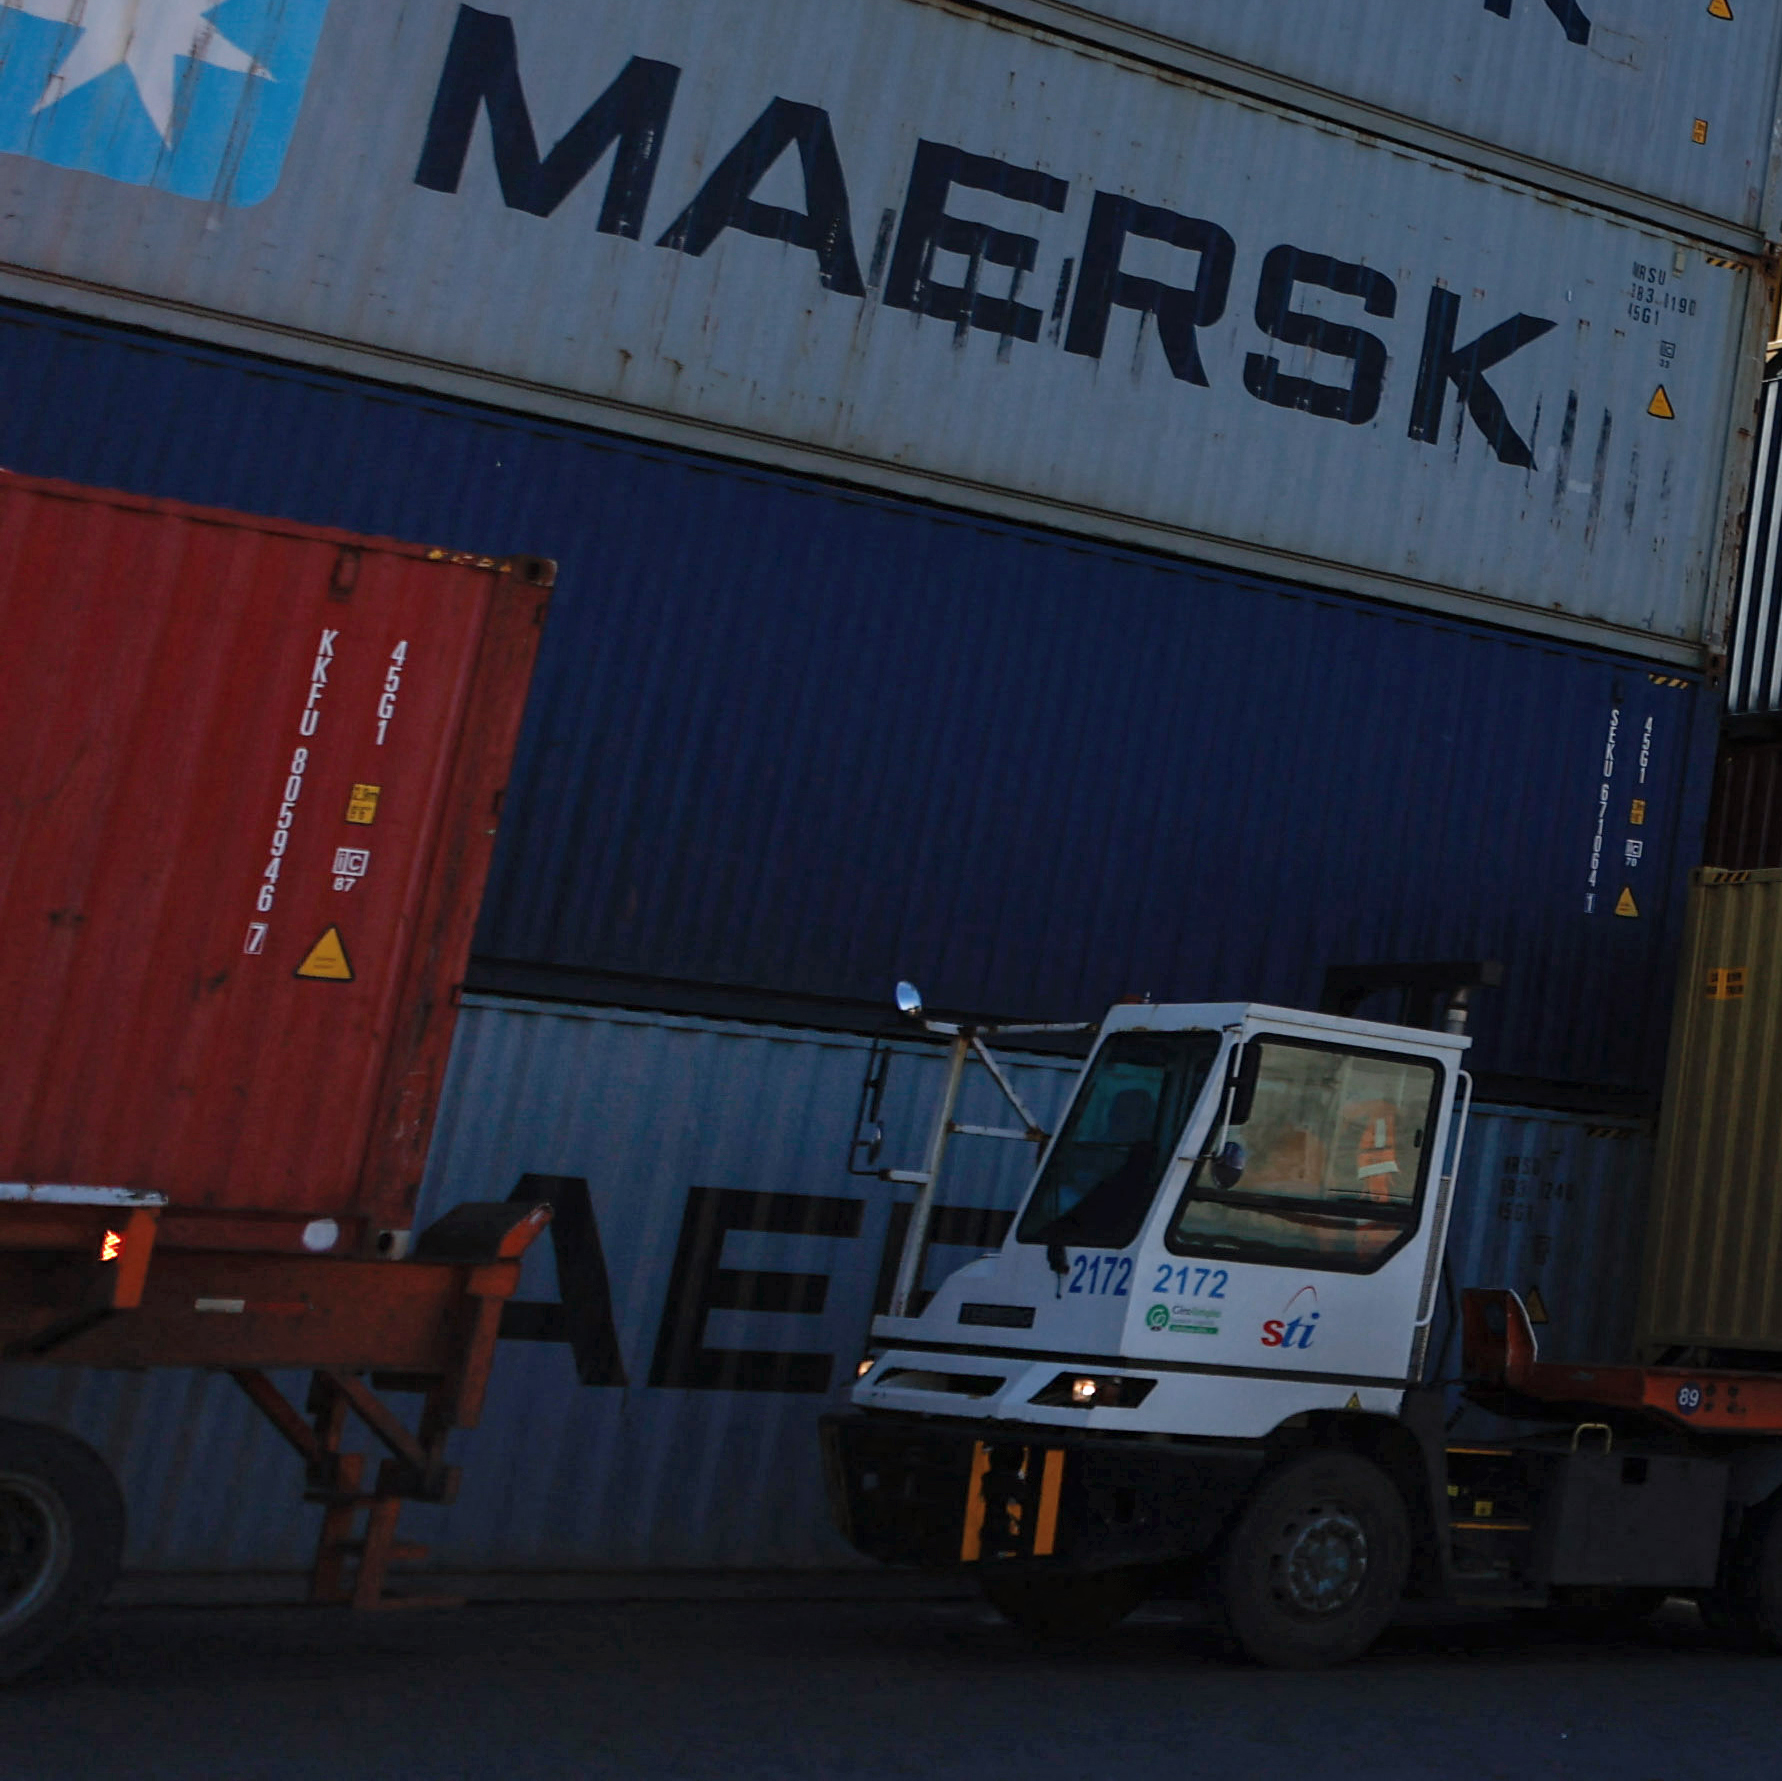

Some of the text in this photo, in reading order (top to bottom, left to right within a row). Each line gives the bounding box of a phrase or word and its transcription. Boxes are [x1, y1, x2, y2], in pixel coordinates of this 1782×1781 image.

[414, 4, 1558, 472] MAERSK
[300, 629, 339, 736] KKFU
[376, 640, 408, 745] 45G1
[1603, 709, 1620, 778] SEKU
[1640, 717, 1653, 784] 45G1
[245, 747, 309, 954] 805946 7
[1588, 784, 1609, 887] 671064
[333, 878, 355, 891] 87
[1069, 1255, 1229, 1298] 2172 2172
[1261, 1313, 1320, 1349] sti
[1678, 1387, 1700, 1407] 89
